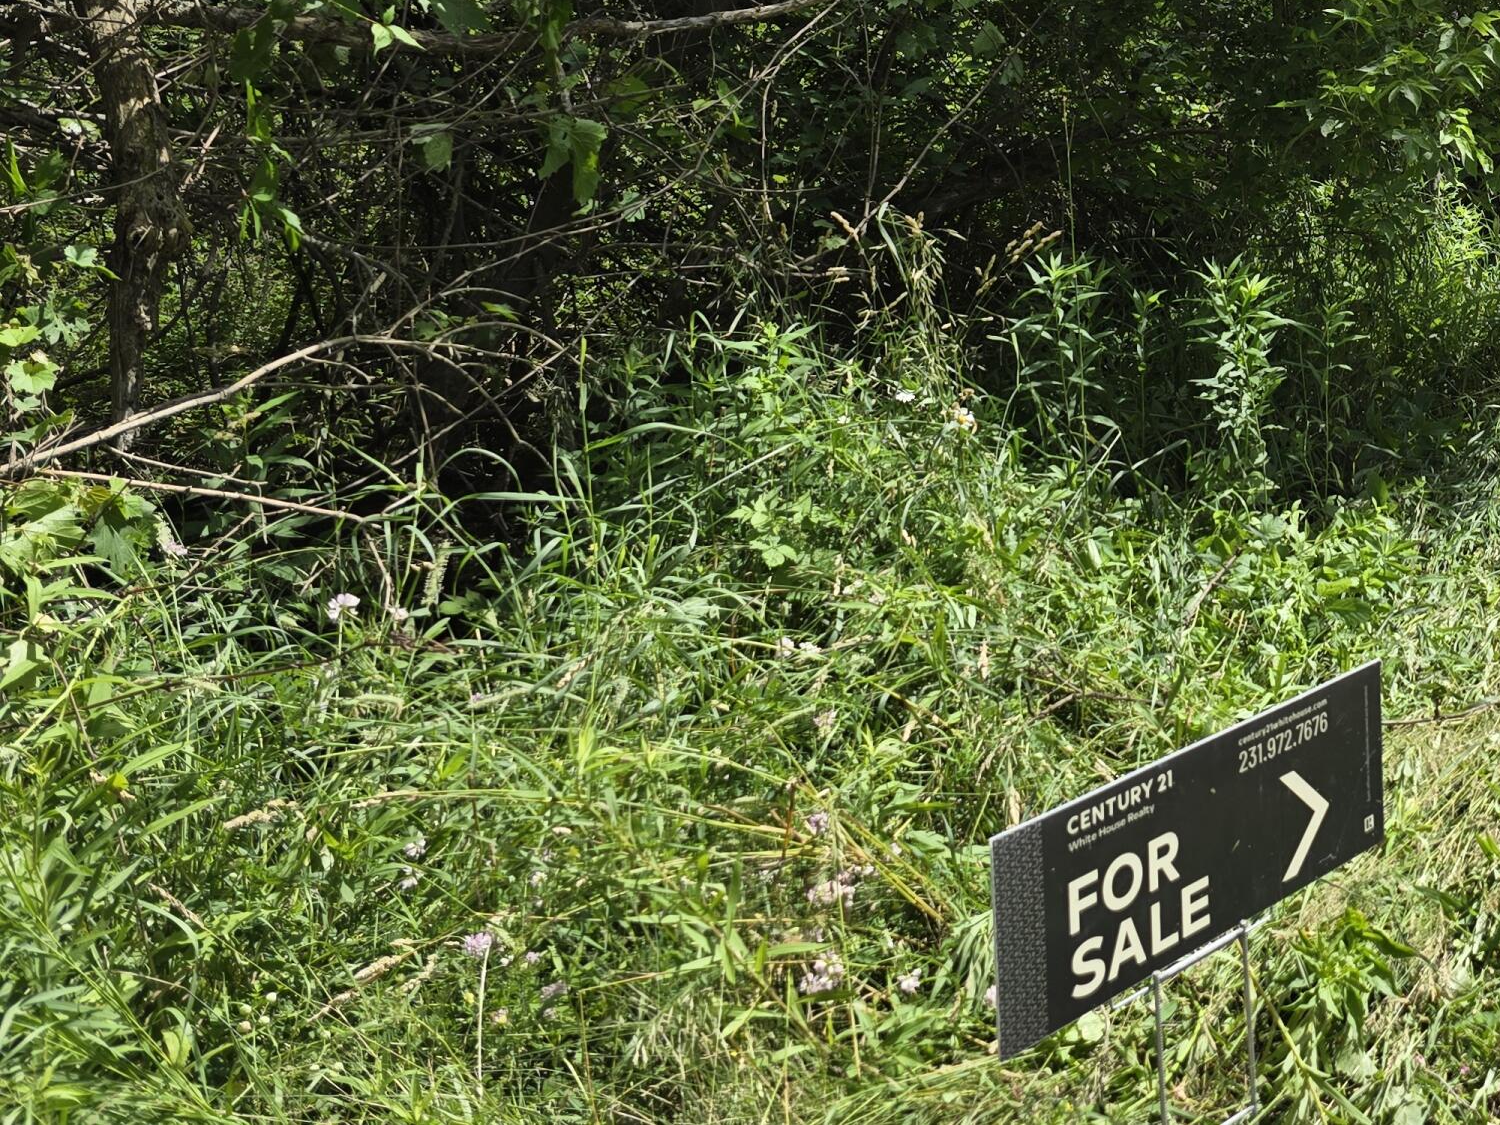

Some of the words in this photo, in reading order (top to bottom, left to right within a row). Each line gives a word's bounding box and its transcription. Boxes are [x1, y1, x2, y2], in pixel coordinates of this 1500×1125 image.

[1238, 712, 1328, 773] 231.972.7676
[1066, 778, 1154, 835] CENTURY
[1157, 769, 1173, 793] 21
[1068, 833, 1097, 852] White
[1098, 818, 1126, 837] House
[1127, 804, 1155, 823] Realty
[1067, 831, 1180, 936] FOR
[1070, 875, 1212, 1000] SALE
